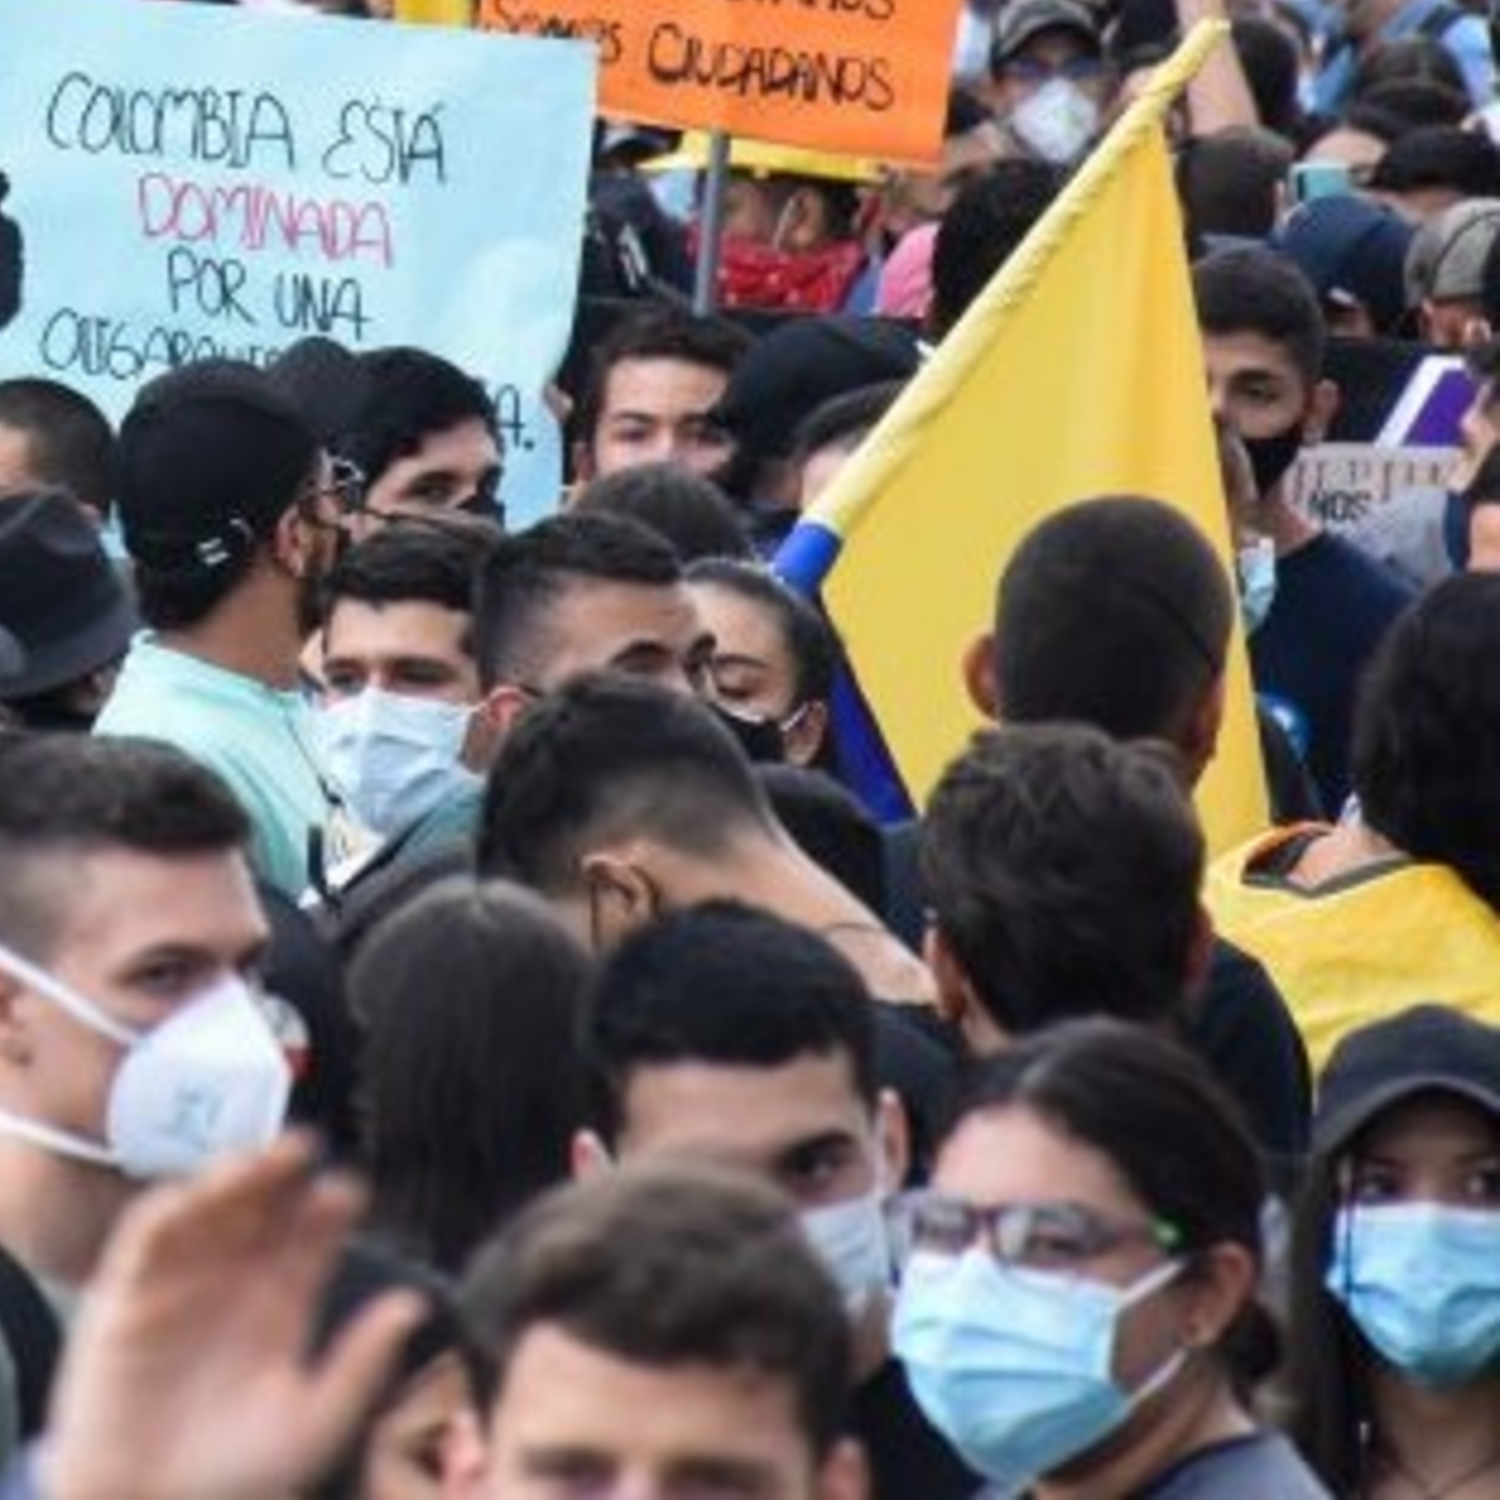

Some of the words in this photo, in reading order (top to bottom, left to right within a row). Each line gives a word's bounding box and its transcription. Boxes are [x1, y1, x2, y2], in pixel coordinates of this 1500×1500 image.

[648, 23, 895, 112] CIUDADANOS
[47, 71, 296, 171] COLOMBIA
[137, 172, 395, 268] DOMINADA
[167, 245, 259, 326] POR
[273, 273, 373, 342] UNA
